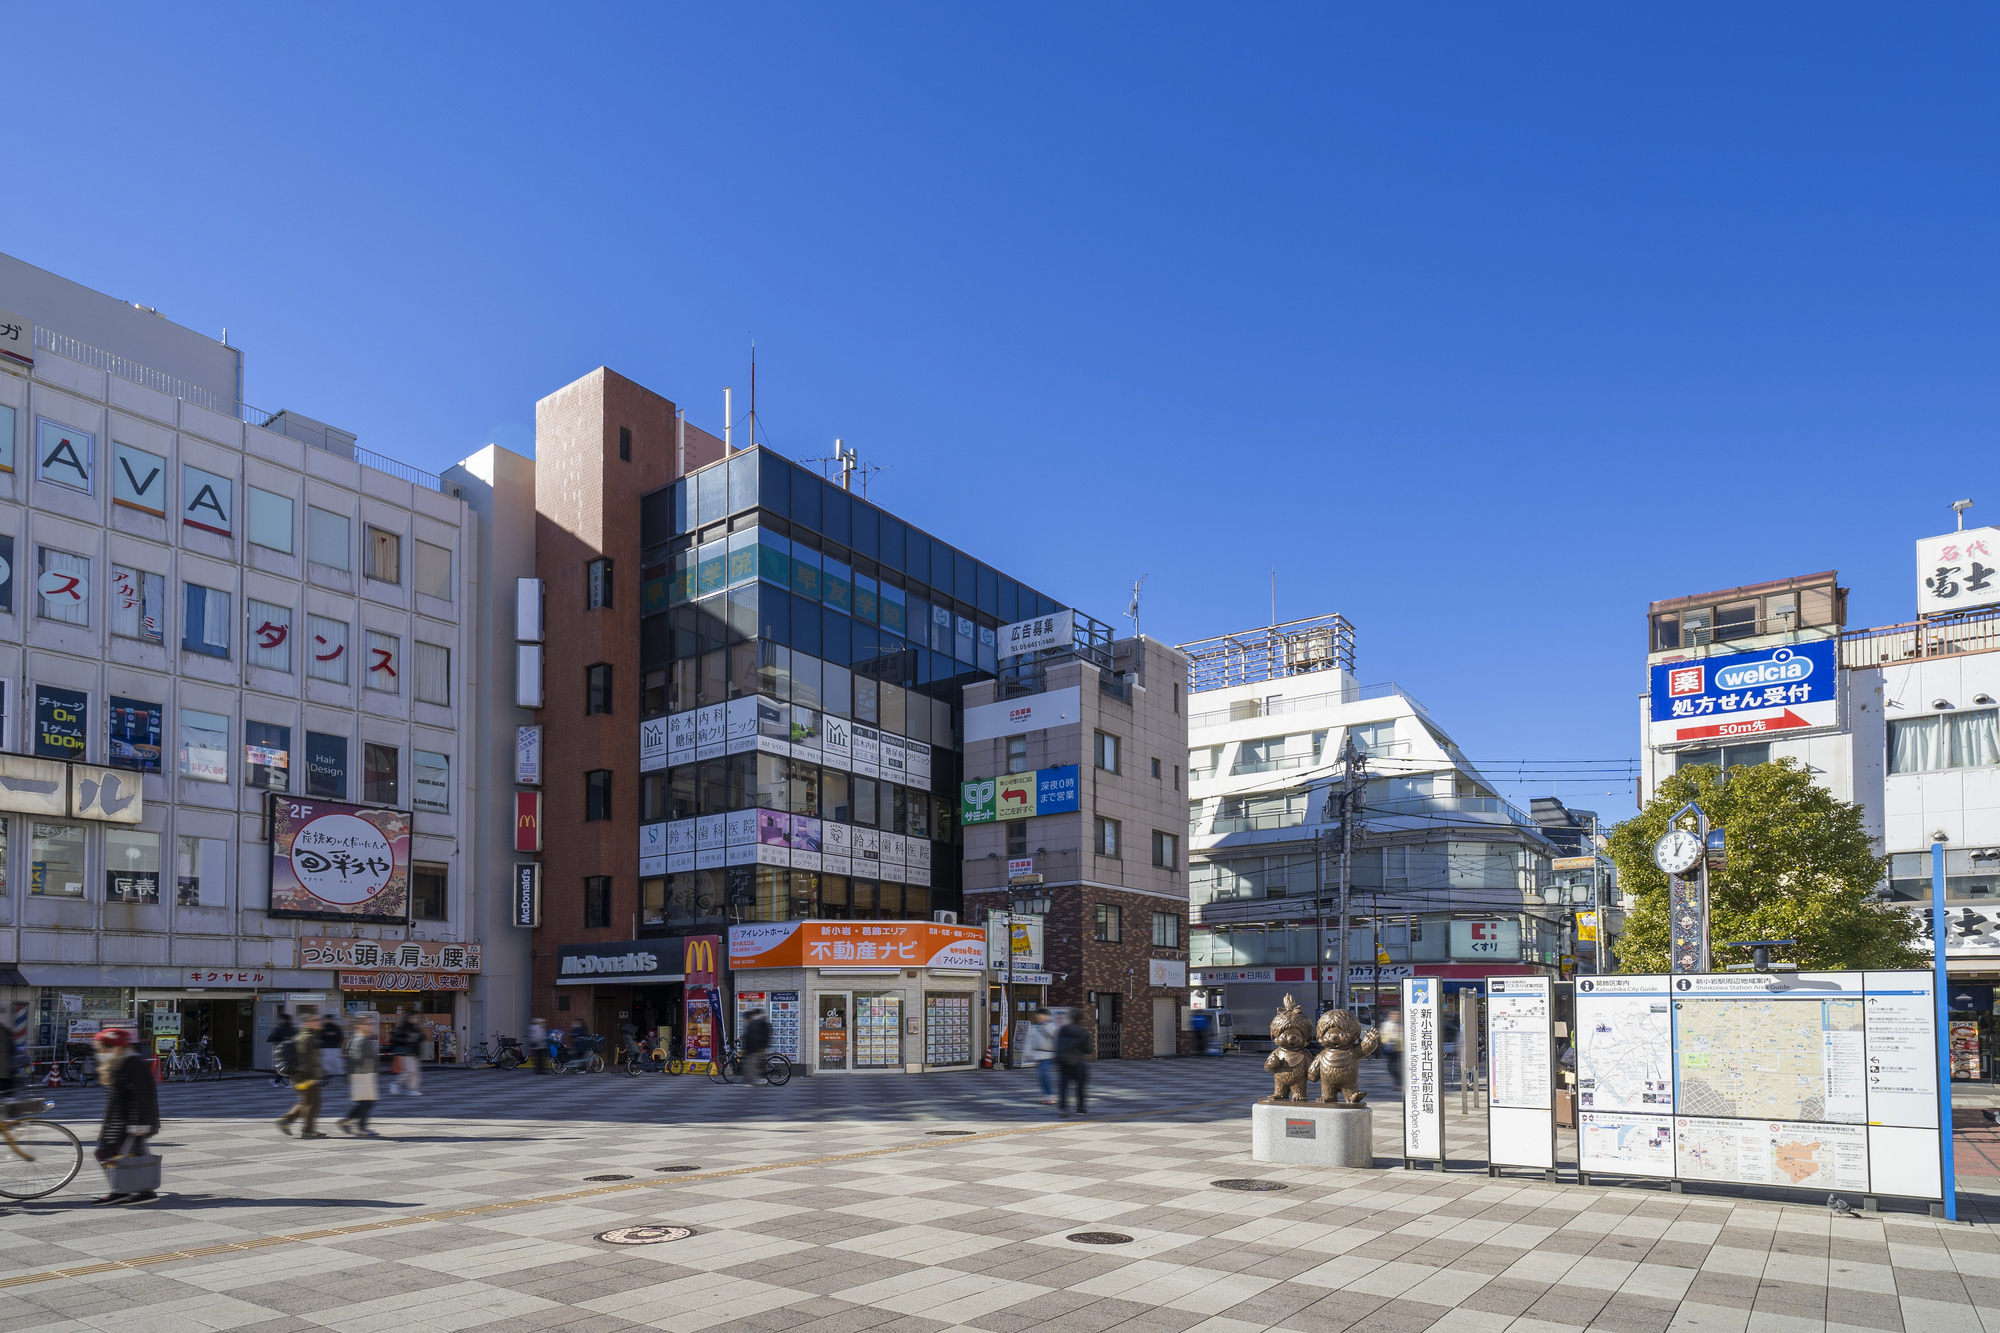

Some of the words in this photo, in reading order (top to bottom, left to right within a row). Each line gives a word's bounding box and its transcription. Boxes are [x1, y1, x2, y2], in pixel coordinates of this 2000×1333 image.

[113, 571, 161, 639] アカデミー
[1011, 617, 1054, 642] 広告募集
[255, 621, 397, 677] ダンス
[1674, 670, 1699, 693] 薬
[1724, 664, 1802, 686] welcia
[38, 697, 85, 712] チャージ
[1672, 683, 1812, 718] 処方せん受付
[53, 709, 76, 723] 0円
[40, 721, 82, 738] 1ゲーム
[675, 718, 756, 748] 糖尿病クリニック
[1719, 721, 1766, 735] 50m先
[42, 733, 84, 750] 100円
[315, 754, 335, 765] Hair
[311, 764, 343, 777] Design
[1040, 778, 1074, 791] 深夜0時
[1040, 790, 1074, 803] まで営業
[290, 804, 313, 819] 2F
[964, 809, 995, 822] サミット
[669, 818, 755, 844] 鈴木歯科医院
[854, 833, 929, 860] 鈴木歯科医院
[521, 868, 531, 924] McDonald's
[740, 927, 790, 938] アイレントホーム
[820, 925, 907, 937] 新小岩・葛飾エリア
[303, 943, 479, 969] つらい頭痛肩こり腰痛
[809, 940, 918, 961] 不動産ナビ
[1471, 942, 1498, 953] くすり
[561, 952, 658, 975] McDonald's
[943, 956, 984, 966] アイレントホーム
[190, 972, 265, 983] キクヤビル
[1215, 971, 1239, 981] 化粧品
[1247, 970, 1271, 980] 日用品
[1409, 1008, 1418, 1042] Shinkoiwa
[1409, 1054, 1419, 1085] Kitaguchi
[1420, 1008, 1434, 1115] 新小岩駅北口駅前広場
[1411, 1086, 1420, 1110] Ekimae
[1410, 1110, 1420, 1129] Open
[1410, 1130, 1420, 1149] Space
